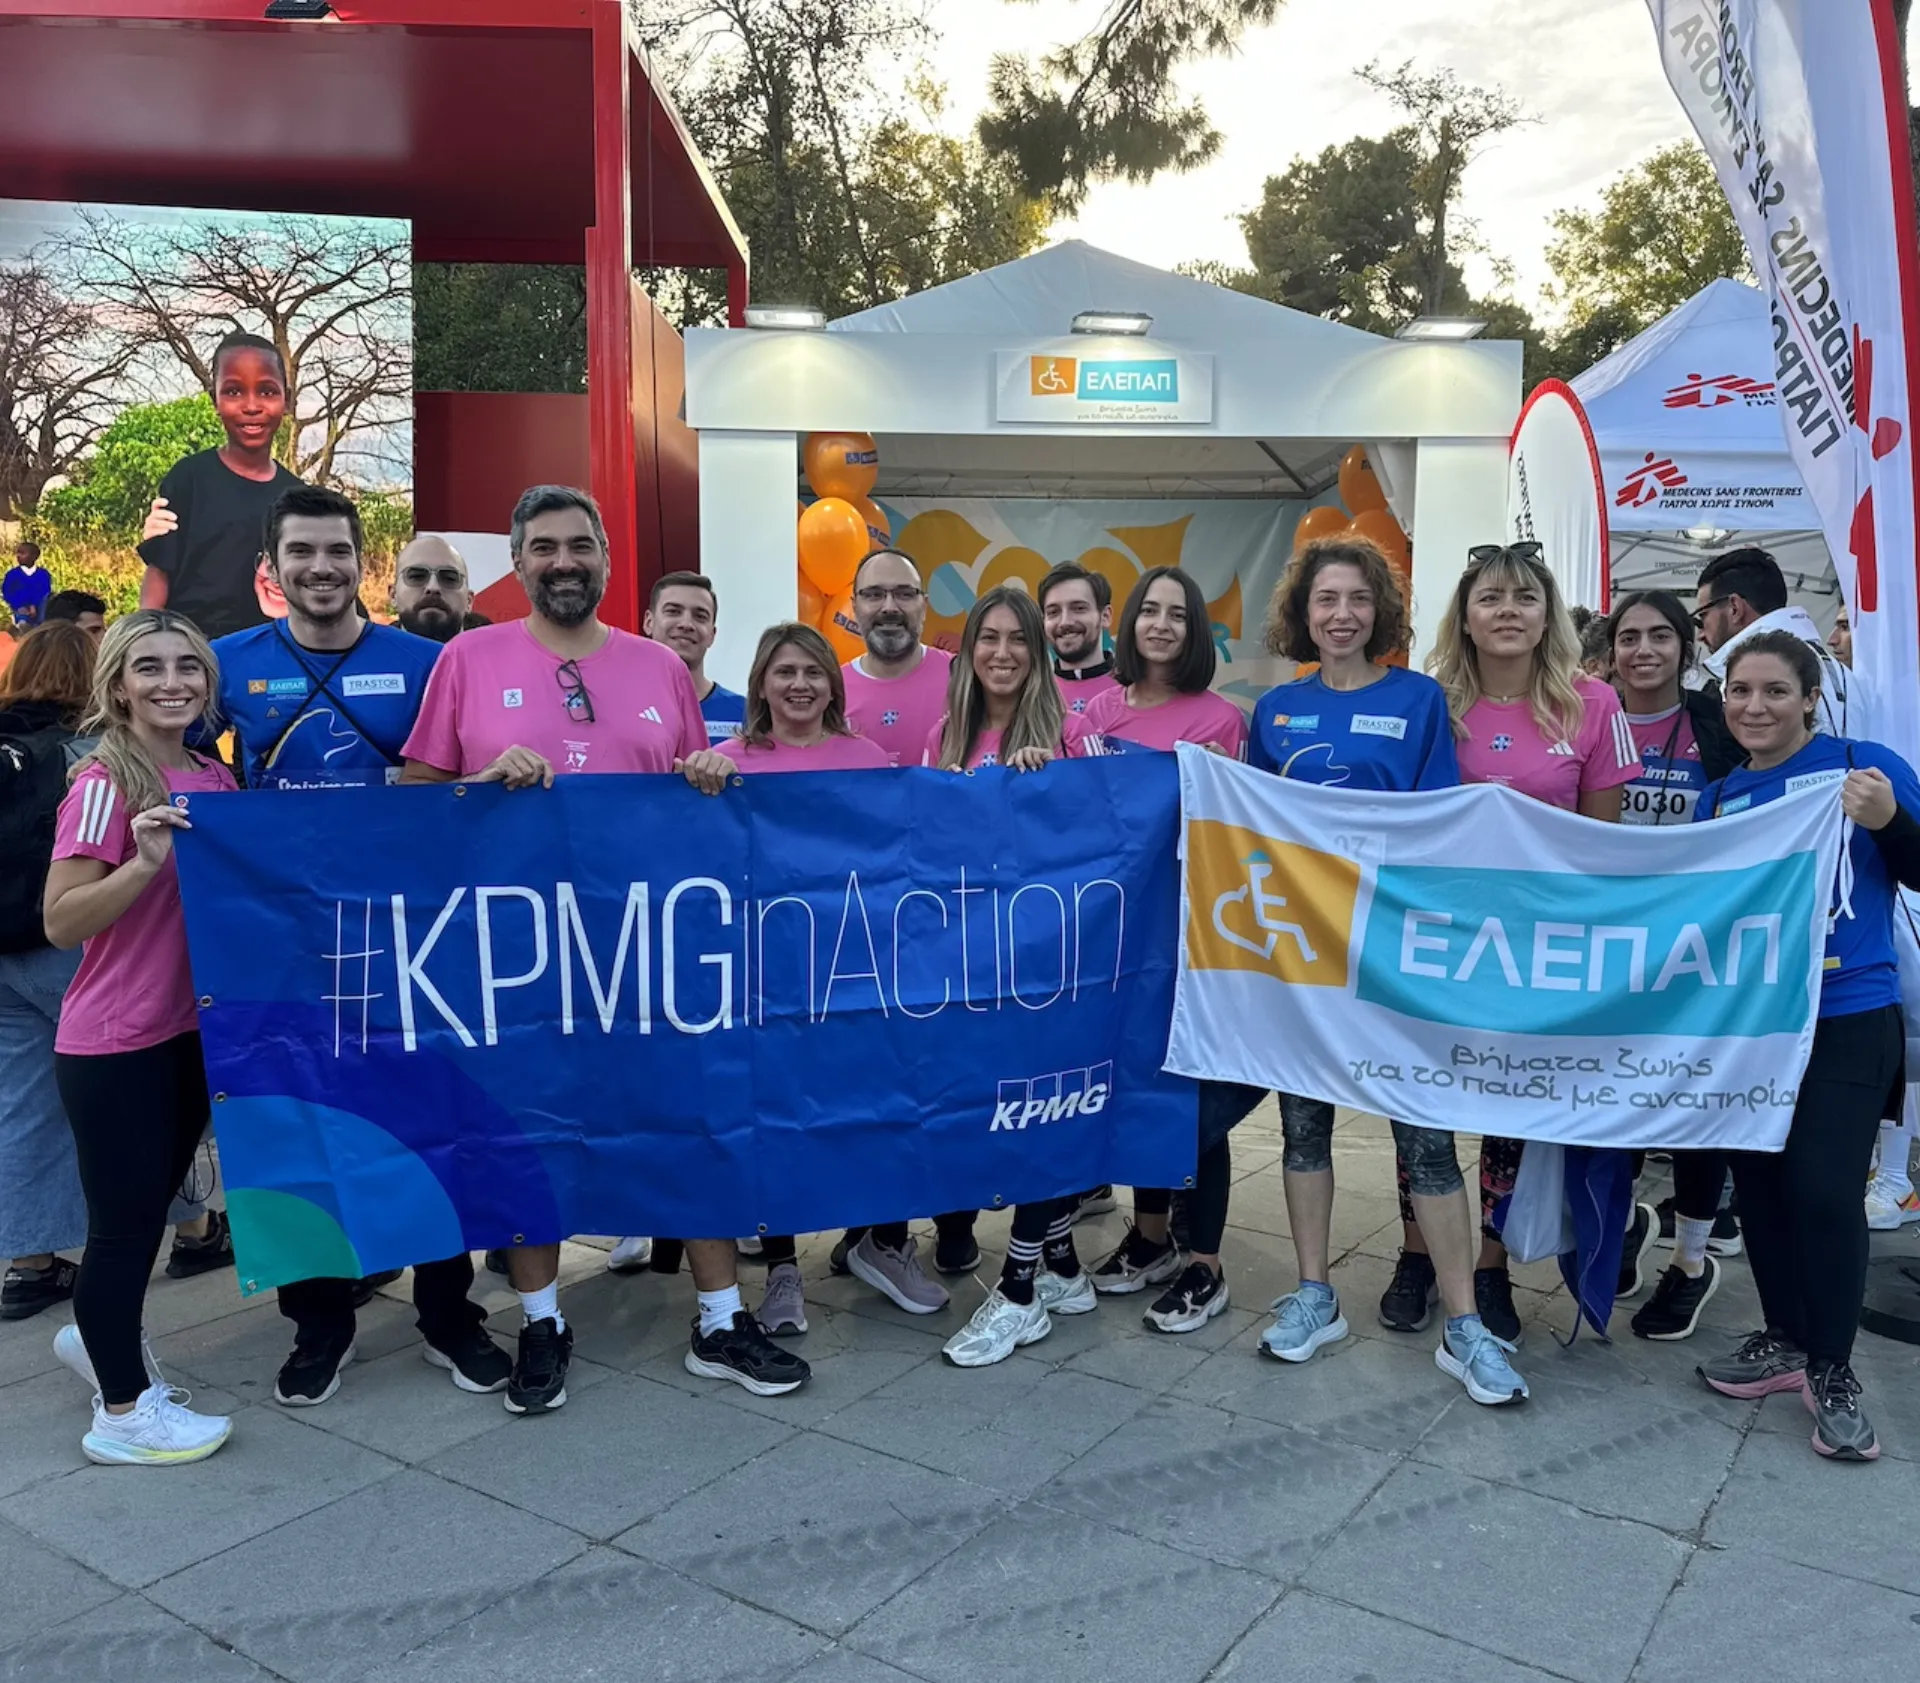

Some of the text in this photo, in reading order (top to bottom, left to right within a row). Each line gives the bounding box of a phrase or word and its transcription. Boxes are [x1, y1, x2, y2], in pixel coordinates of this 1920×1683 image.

[1087, 372, 1170, 391] ΕΛΕΠΑΠ
[1659, 499, 1774, 509] ΓΙΑΤΡΟΙ ΧΩΡΙΣ ΣΥΝΟΡΑ
[1662, 487, 1803, 497] MEDECINS SANS FRONTIERES
[349, 679, 400, 690] TRASTOR
[1356, 719, 1402, 732] TRASTOR
[320, 865, 1125, 1057] #KPMGinAction
[1399, 908, 1782, 993] ΕΛΕΠΑΠ
[1451, 1043, 1713, 1079] Βήματα ζωής
[1349, 1059, 1800, 1114] για το παιδί με αναπηρία
[989, 1083, 1107, 1131] KPMG
